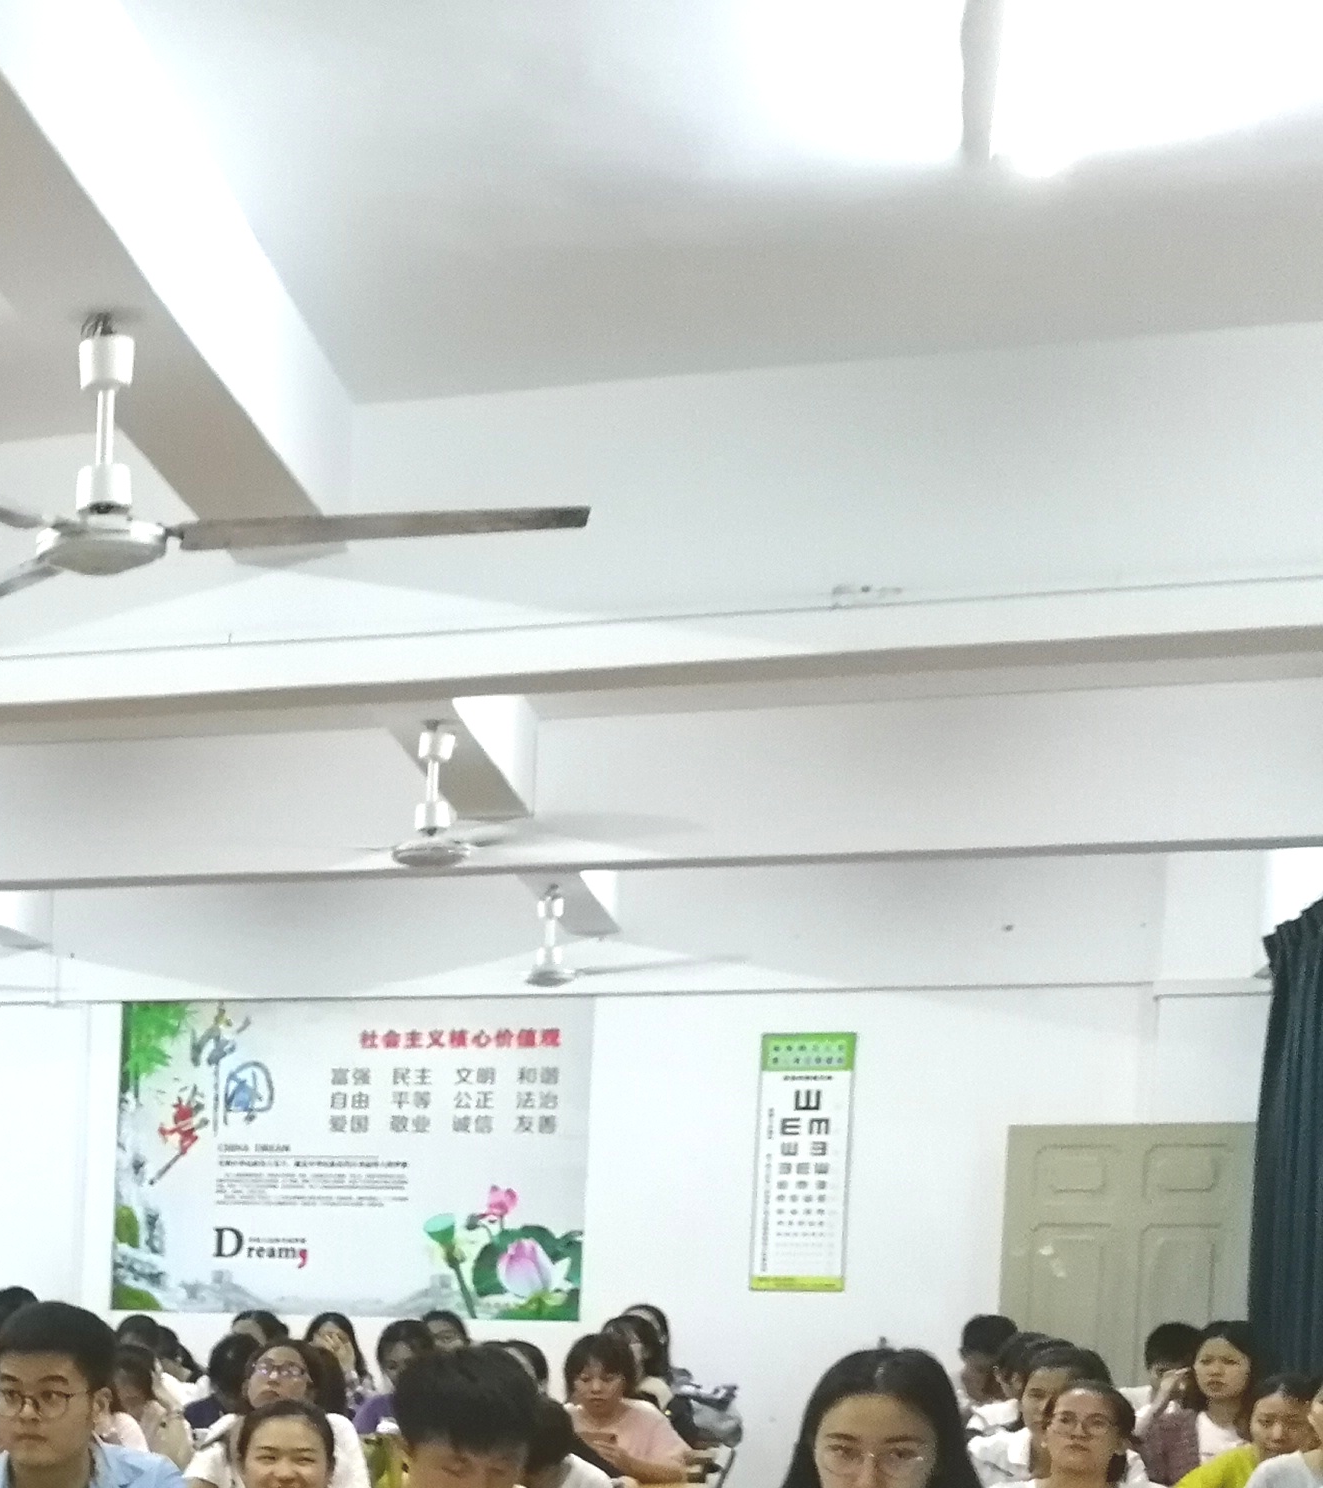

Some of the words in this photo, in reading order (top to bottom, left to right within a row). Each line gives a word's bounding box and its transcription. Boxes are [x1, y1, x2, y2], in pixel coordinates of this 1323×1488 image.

[360, 1028, 561, 1049] 社会主义核心价值观
[331, 1067, 371, 1086] 富强
[393, 1067, 432, 1086] 民主
[455, 1067, 496, 1086] 文明
[517, 1067, 559, 1086] 和谐
[330, 1091, 369, 1110] 自由
[392, 1091, 431, 1110] 平等
[453, 1091, 494, 1110] 公正
[516, 1091, 558, 1110] 法治
[329, 1114, 369, 1134] 爱国
[390, 1114, 431, 1134] 敬业
[452, 1114, 493, 1134] 诚信
[514, 1114, 557, 1134] 友善
